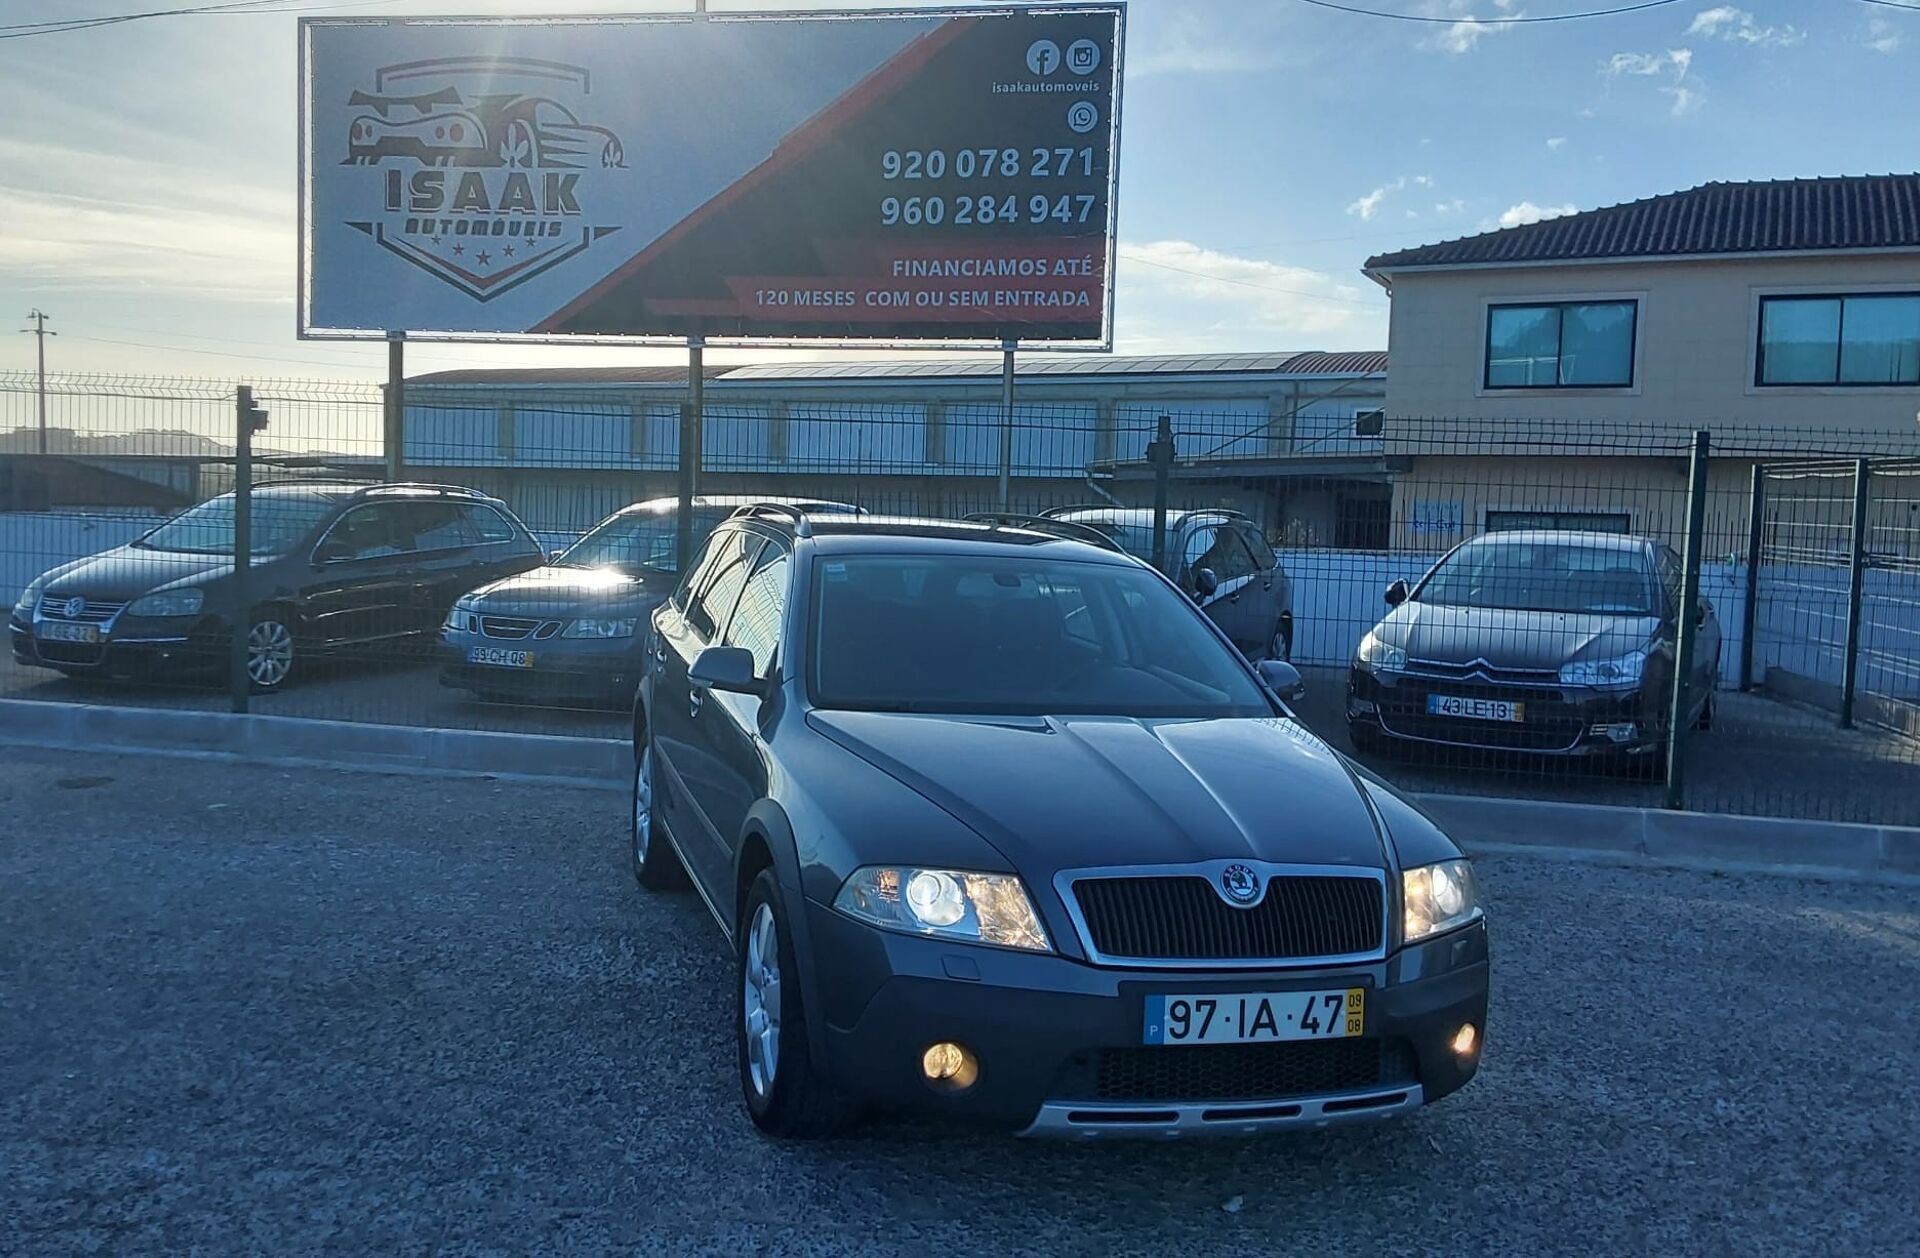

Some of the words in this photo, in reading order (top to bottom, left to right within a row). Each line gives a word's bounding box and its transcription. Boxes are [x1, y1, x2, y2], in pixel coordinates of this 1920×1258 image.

[991, 80, 1100, 93] isaakautomoveis
[882, 150, 946, 179] 920
[956, 148, 1020, 178] 078
[1030, 147, 1093, 176] 271
[385, 169, 582, 216] ISAAK
[881, 197, 945, 225] 960
[954, 195, 1019, 224] 284
[1029, 194, 1096, 223] 947
[405, 217, 563, 237] AUTOMÓVEIS
[892, 258, 1048, 277] FINANCIAMOS
[1052, 254, 1093, 276] ATÉ
[755, 290, 789, 305] 120
[794, 290, 855, 306] MESES
[865, 291, 910, 306] COM
[915, 291, 943, 306] OU
[949, 291, 989, 306] SEM
[995, 290, 1091, 306] ENTRADA
[1348, 994, 1362, 1008] 09
[1149, 1025, 1159, 1036] P
[1347, 1019, 1361, 1033] 08
